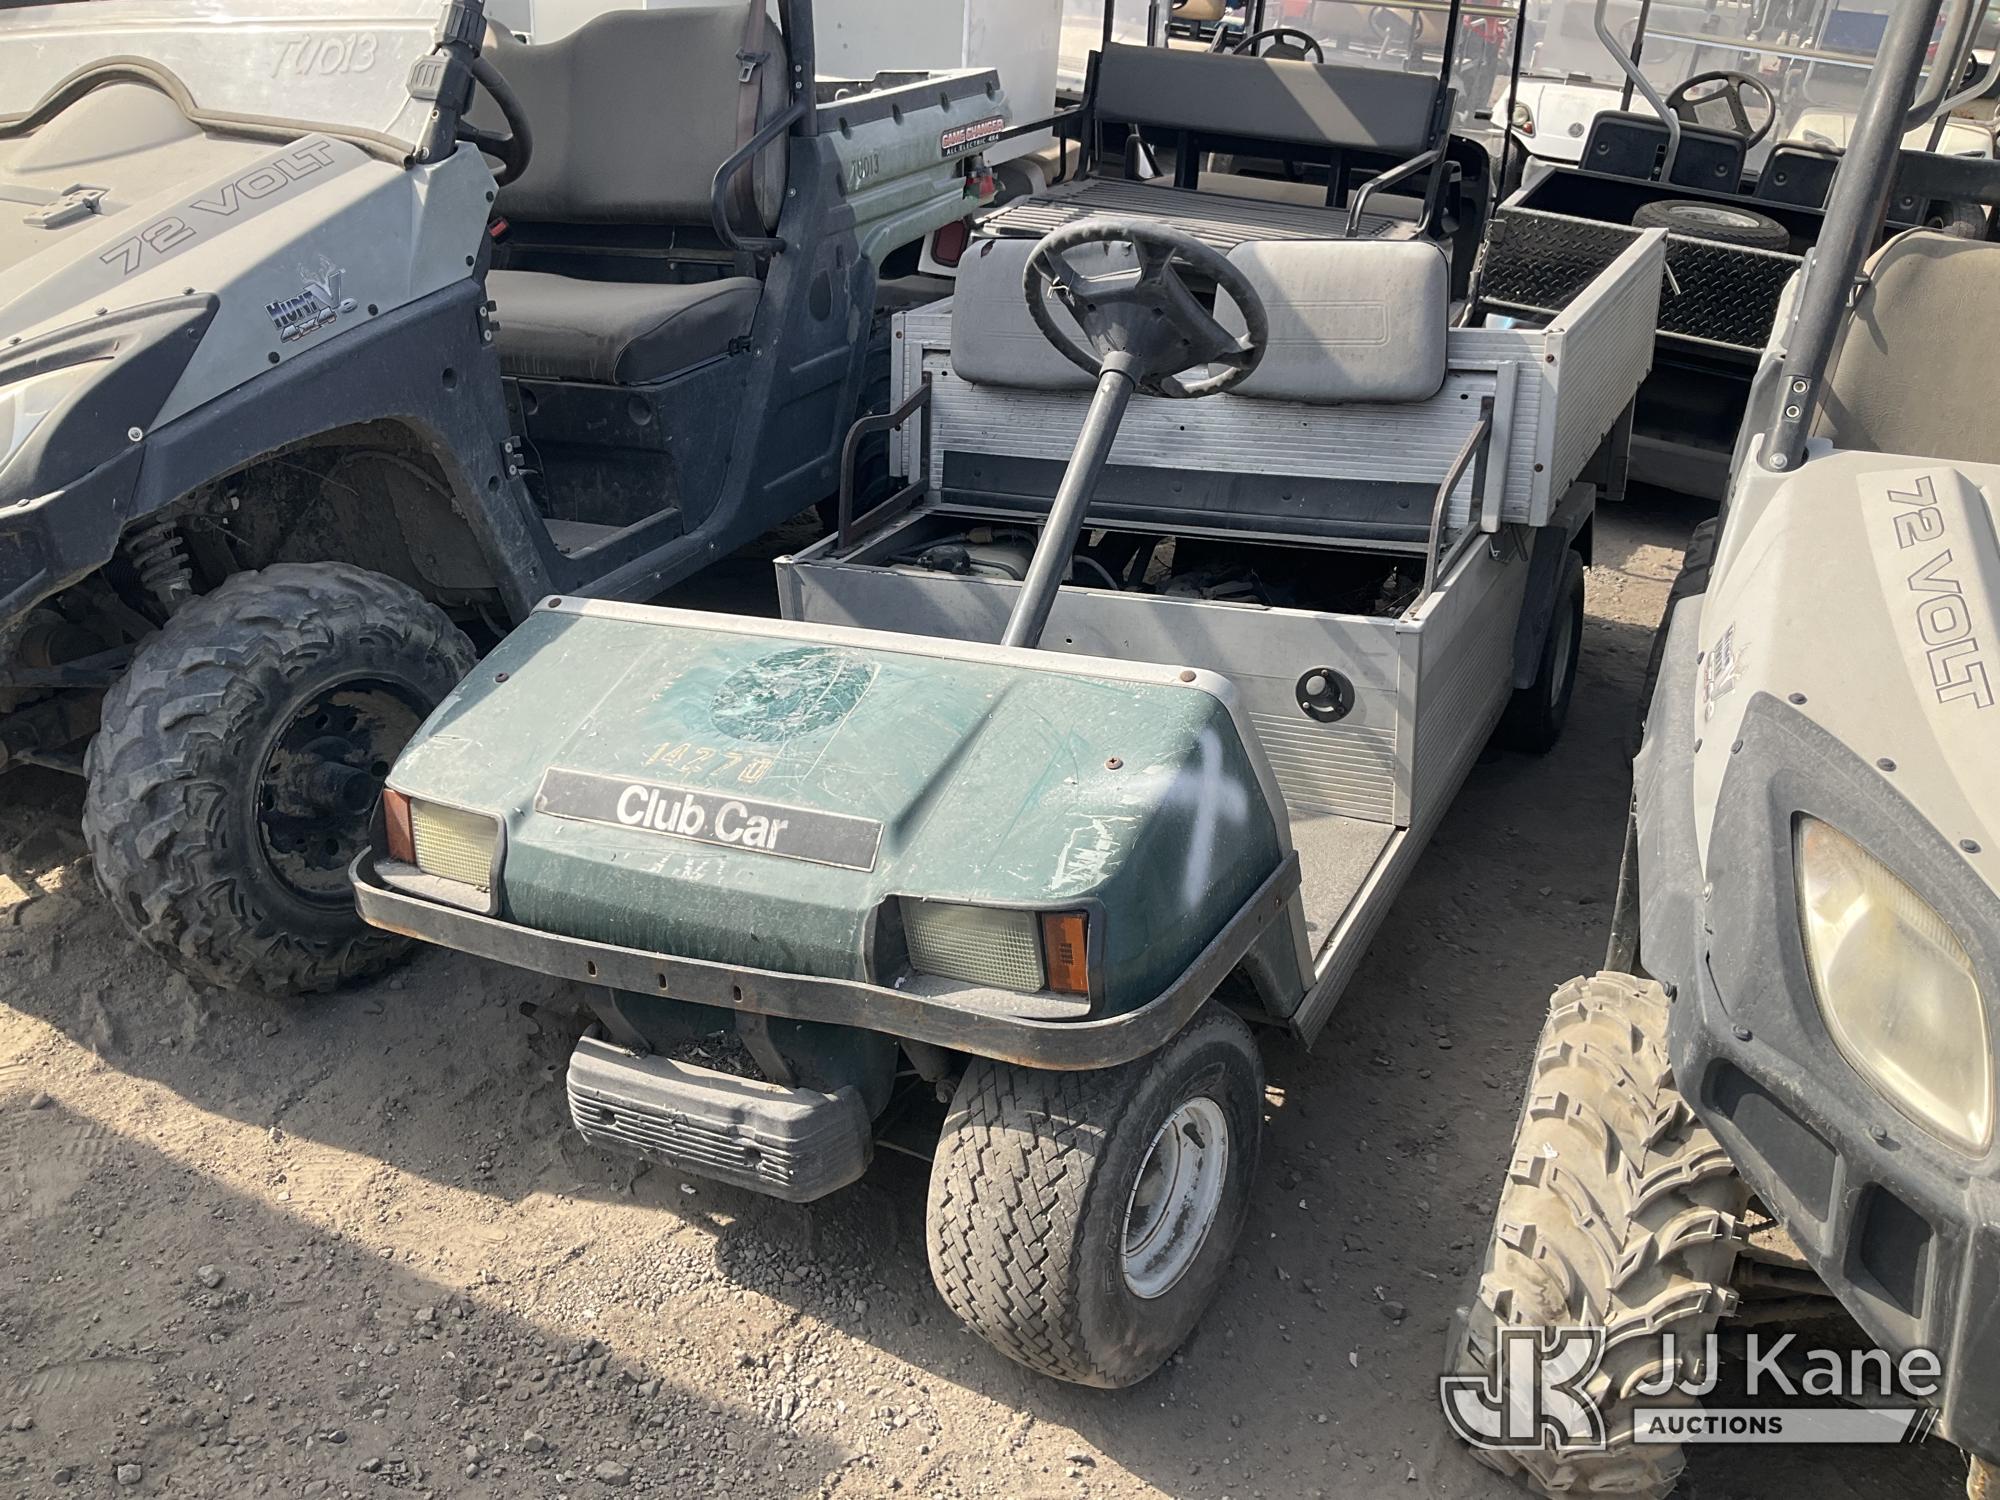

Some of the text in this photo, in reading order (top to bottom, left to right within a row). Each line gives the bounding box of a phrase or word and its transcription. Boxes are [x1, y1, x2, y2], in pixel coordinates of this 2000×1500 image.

[942, 119, 1004, 149] GAME CHANGER
[946, 145, 958, 155] ALL
[959, 137, 986, 151] ELECTRIC
[100, 140, 335, 275] 72 VOLT
[1887, 475, 1995, 709] 72 VOLT
[616, 785, 789, 850] Club Car
